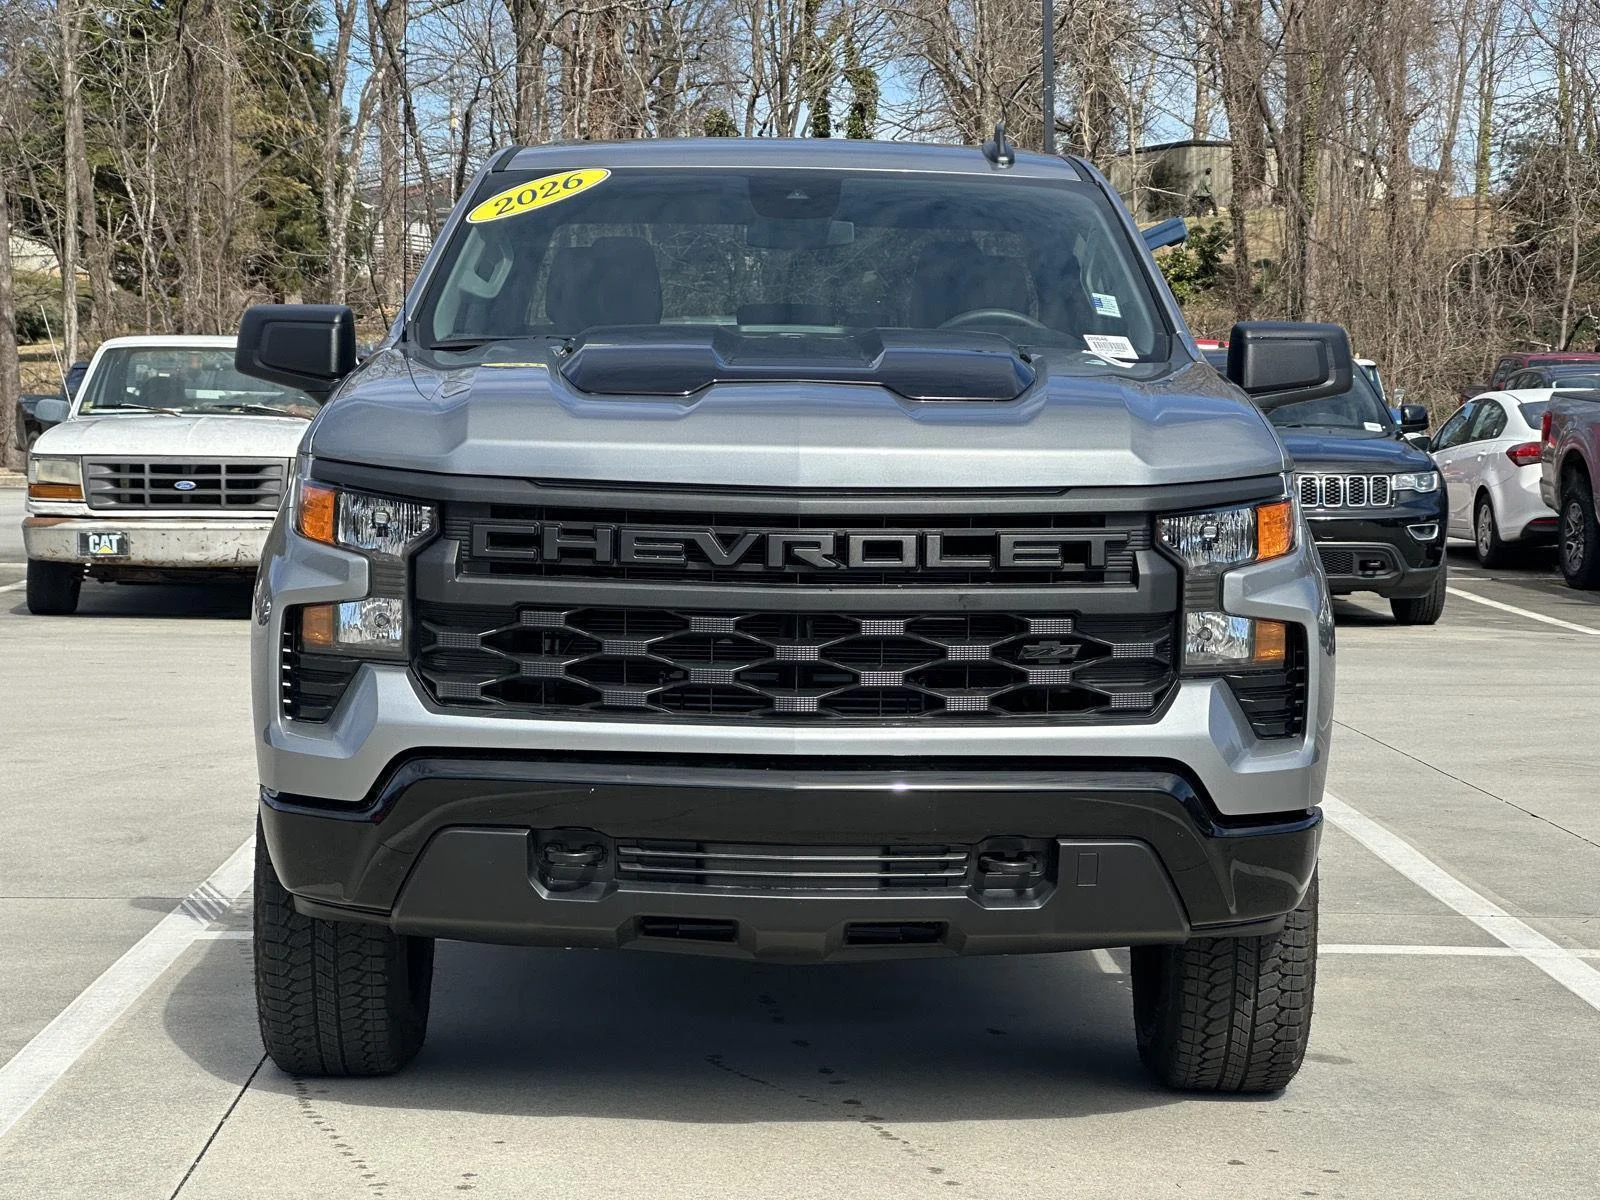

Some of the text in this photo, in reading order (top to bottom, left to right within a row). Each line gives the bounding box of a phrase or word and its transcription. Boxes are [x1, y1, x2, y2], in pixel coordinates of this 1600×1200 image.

[493, 173, 584, 216] 2026
[89, 534, 122, 554] CAT
[470, 521, 1130, 571] CHEVROLET
